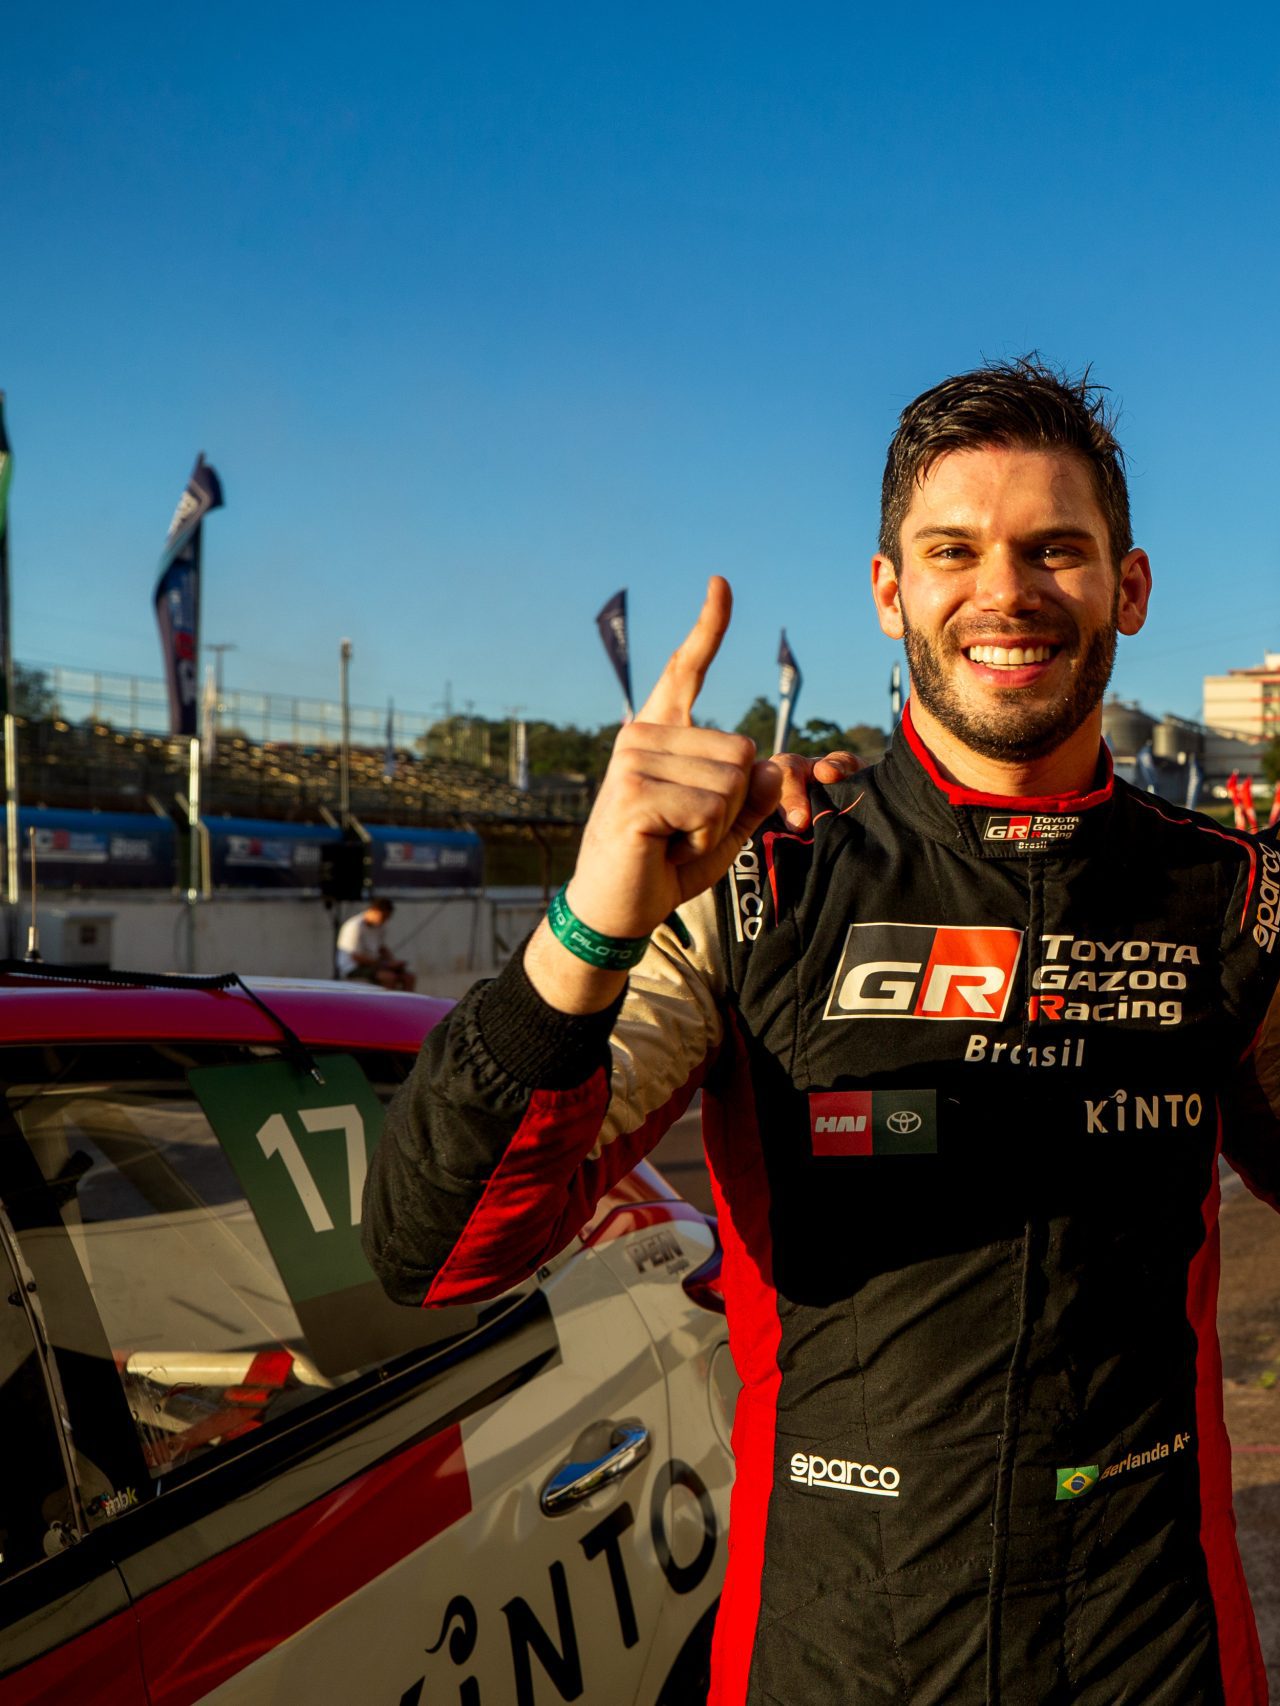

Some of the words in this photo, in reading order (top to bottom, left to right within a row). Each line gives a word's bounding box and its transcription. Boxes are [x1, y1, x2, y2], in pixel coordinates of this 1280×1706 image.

[987, 825, 1028, 839] GR
[1034, 816, 1079, 824] TOYOTA
[1018, 841, 1047, 849] Brasil
[1031, 831, 1073, 840] Racing
[728, 837, 763, 942] arco
[570, 931, 632, 959] PILOTO
[1039, 934, 1201, 965] TOYOTA
[838, 961, 1006, 1014] GR
[1032, 965, 1187, 992] GAZOO
[1028, 995, 1183, 1026] Racing
[964, 1034, 1085, 1068] Brasil
[256, 1104, 367, 1232] 17
[1173, 1432, 1191, 1453] A+
[790, 1452, 900, 1497] sparco
